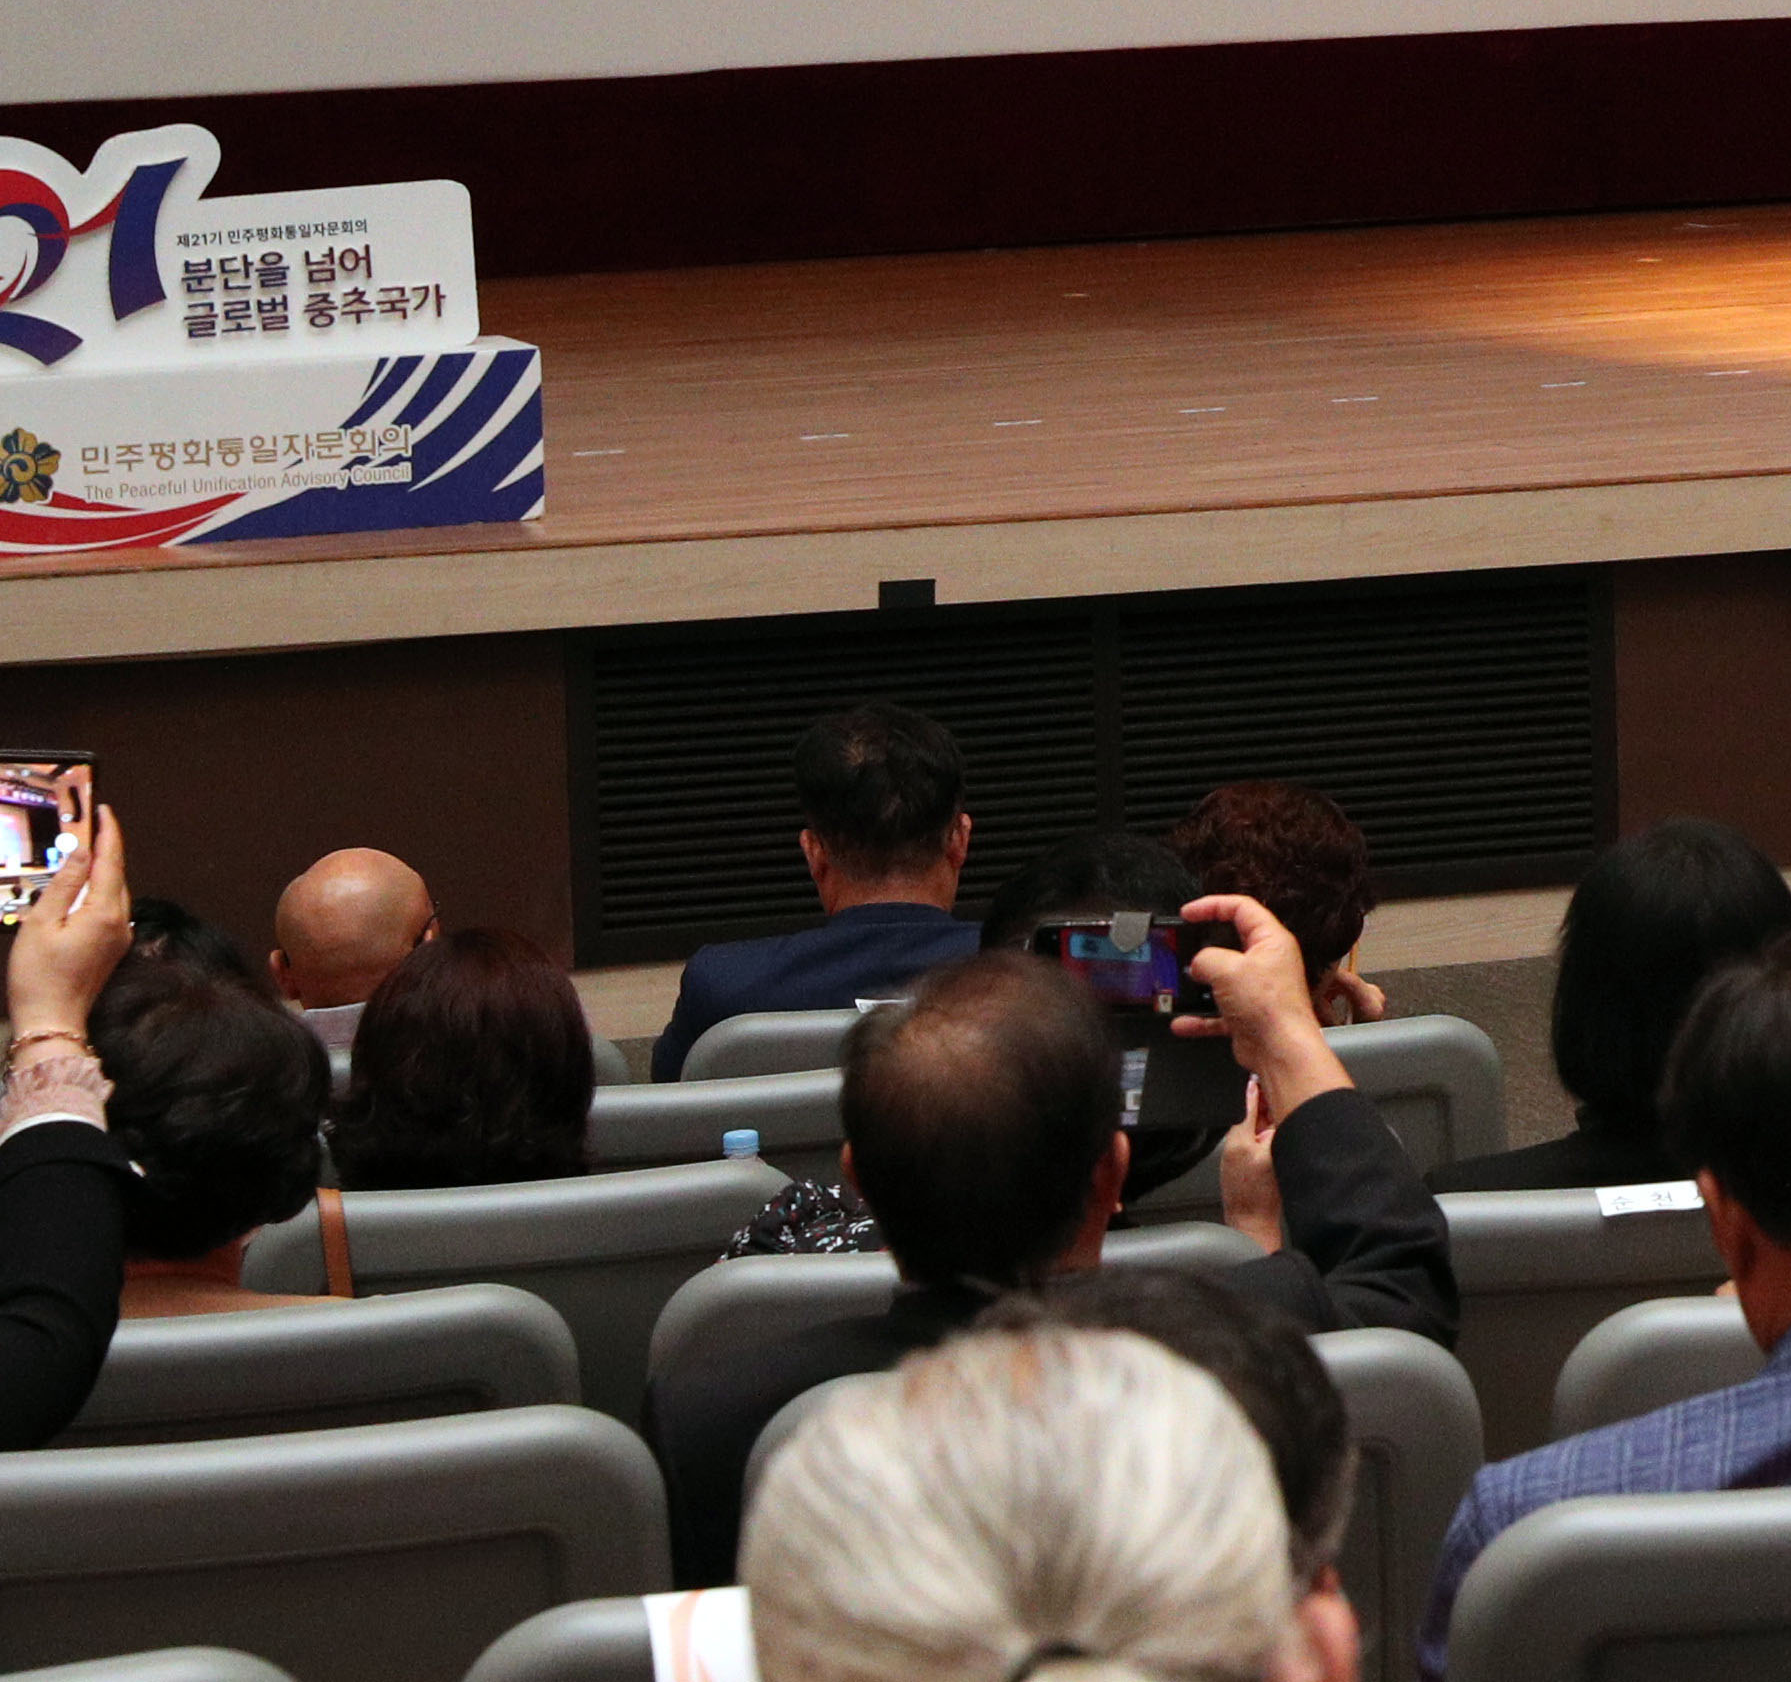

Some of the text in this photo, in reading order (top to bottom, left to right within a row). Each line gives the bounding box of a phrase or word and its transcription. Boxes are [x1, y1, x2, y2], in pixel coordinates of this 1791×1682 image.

[176, 219, 368, 247] 제21기 민주평화통일자문회의
[181, 244, 372, 294] 분단을 넘어
[184, 283, 446, 338] 글로벌 중추국가
[81, 427, 411, 474] 민주평화통일자문회의
[85, 465, 411, 501] The Peaceful Unification Advisory Council
